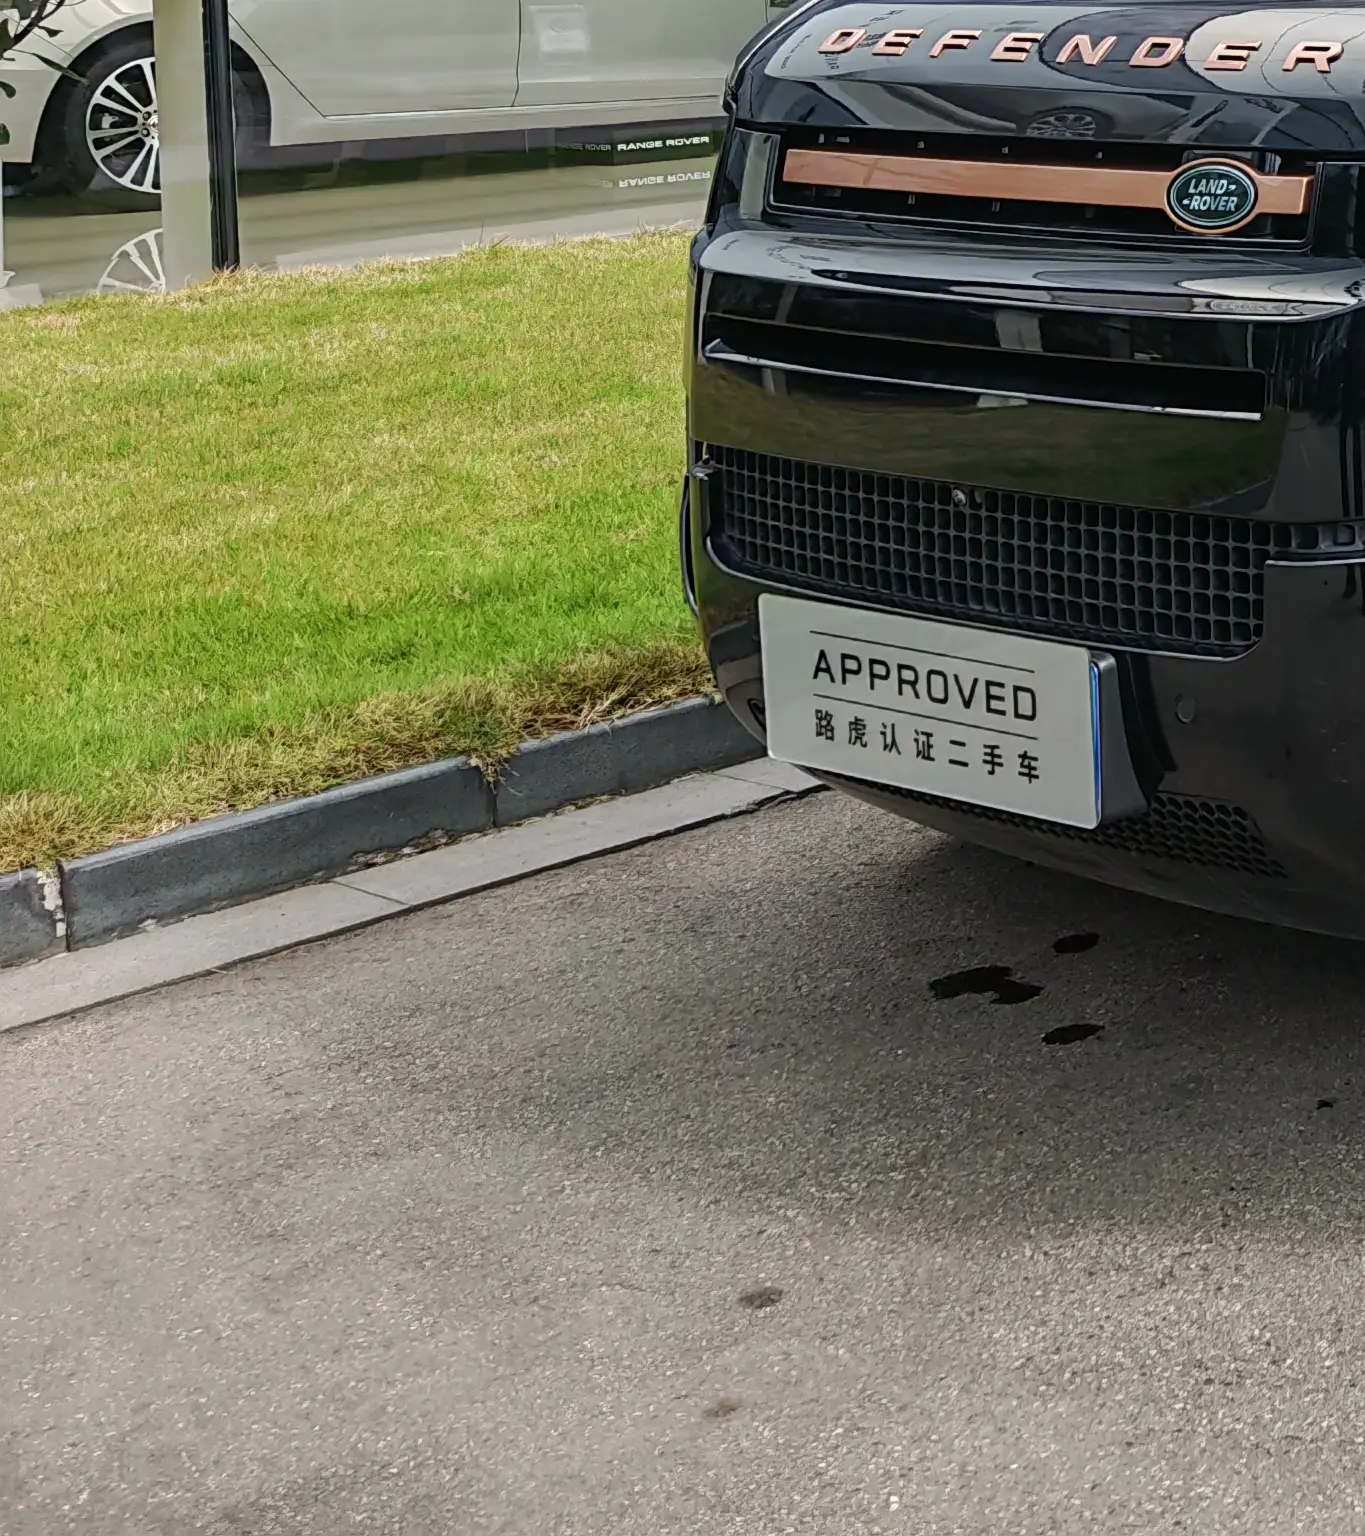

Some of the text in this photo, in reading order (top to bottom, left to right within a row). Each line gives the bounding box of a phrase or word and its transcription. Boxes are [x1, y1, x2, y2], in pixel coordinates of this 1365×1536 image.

[817, 27, 1345, 74] DEFENDER
[617, 136, 709, 151] RANGE ROVER
[1188, 179, 1228, 195] LAND
[1189, 195, 1238, 212] ROVER
[812, 649, 1038, 722] APPROVED
[814, 709, 1041, 785] 路虎认证二手车
